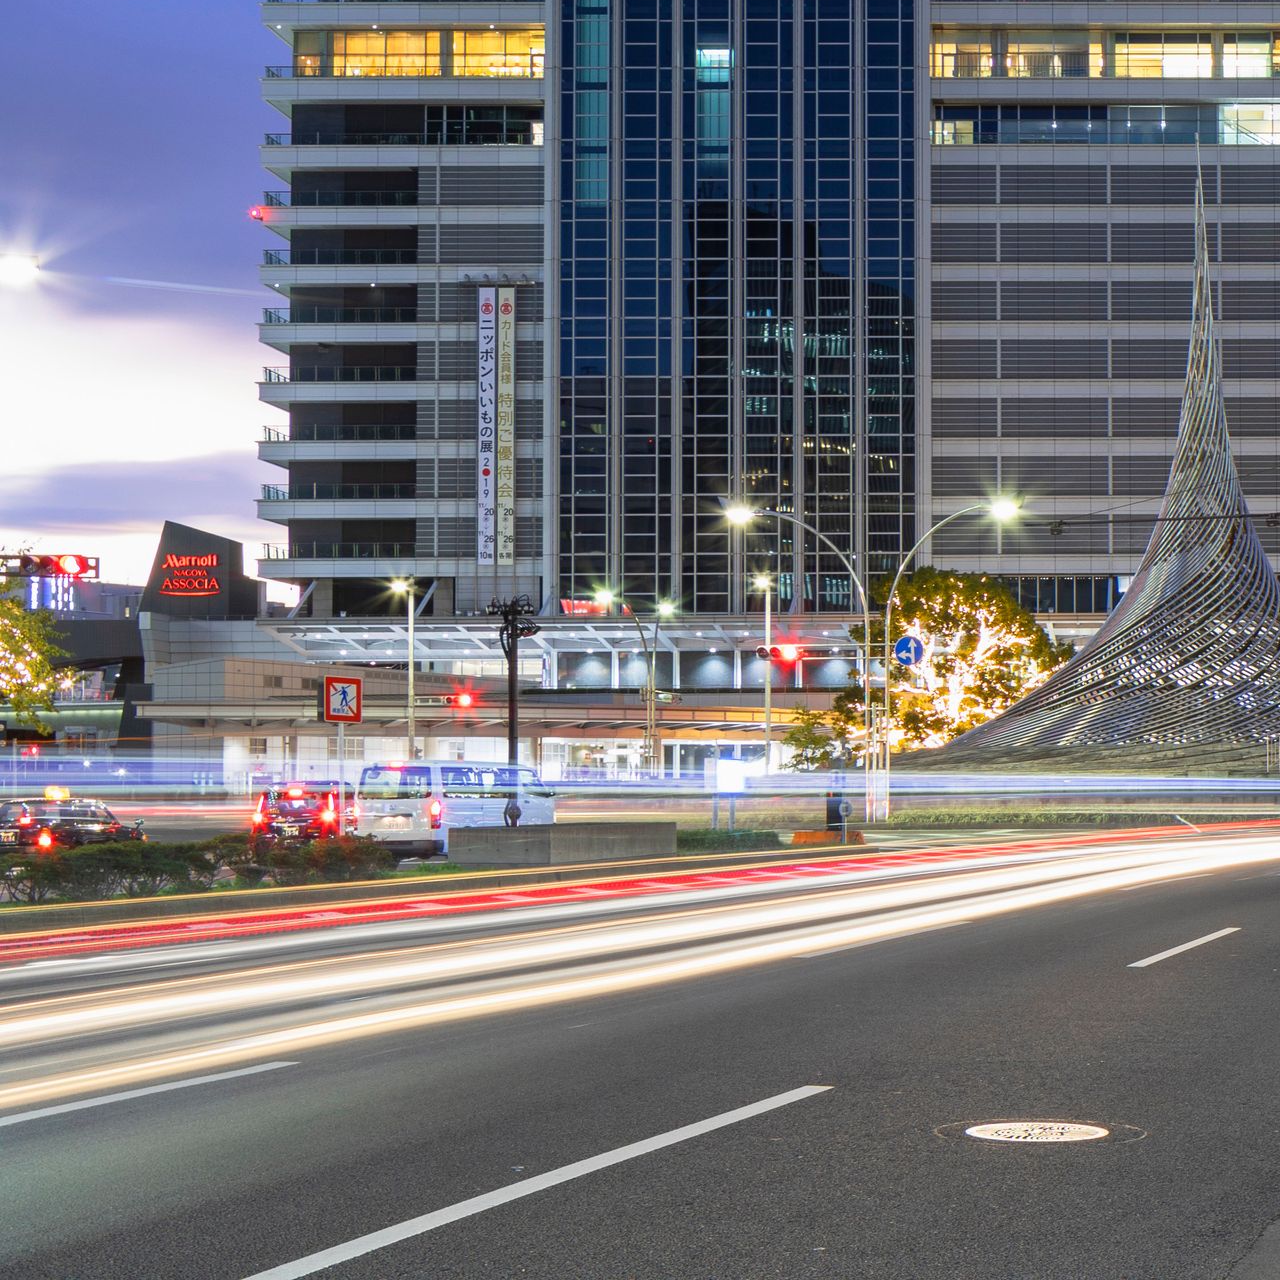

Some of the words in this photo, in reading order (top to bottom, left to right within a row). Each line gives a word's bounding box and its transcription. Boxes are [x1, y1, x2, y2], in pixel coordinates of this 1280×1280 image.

[161, 553, 218, 568] Marriott
[173, 569, 208, 577] NAGOYA
[162, 577, 219, 590] ASSOCIA
